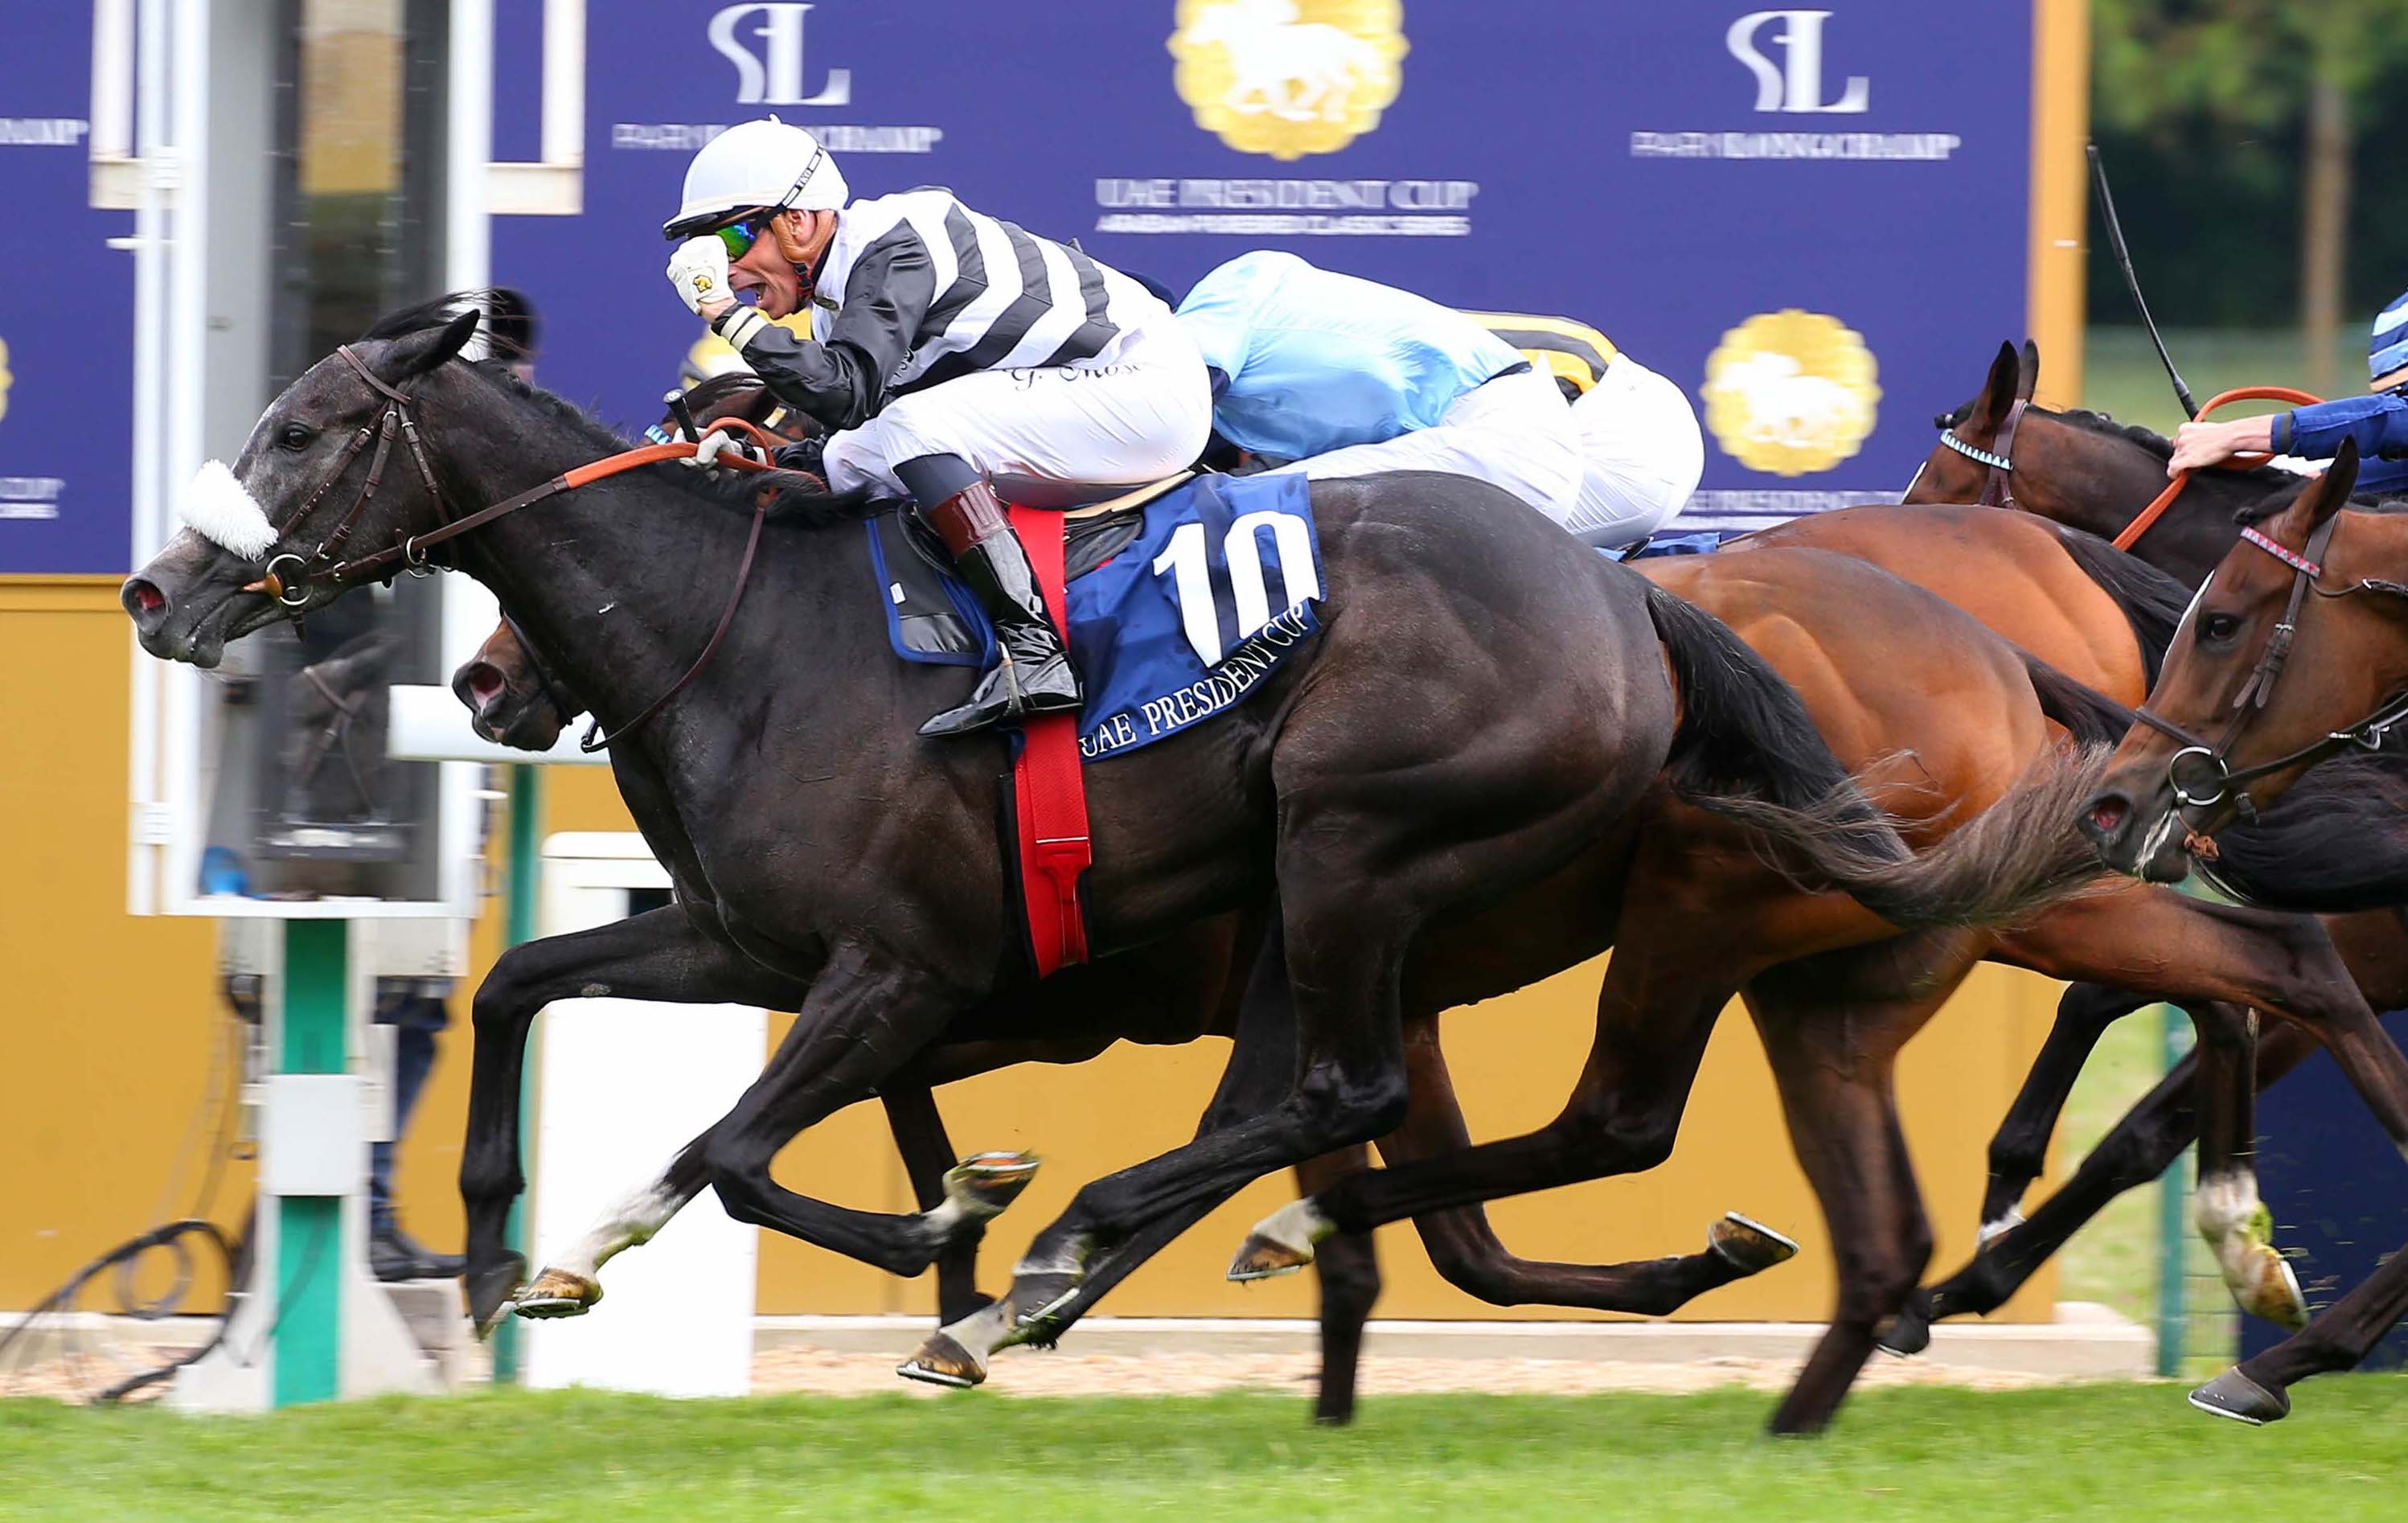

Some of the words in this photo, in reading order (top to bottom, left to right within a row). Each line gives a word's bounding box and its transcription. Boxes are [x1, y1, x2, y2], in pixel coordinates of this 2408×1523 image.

[1153, 510, 1321, 668] 10
[1078, 712, 1137, 757] UAE
[1141, 637, 1279, 737] PRESIDENT
[1261, 602, 1309, 647] CUP
